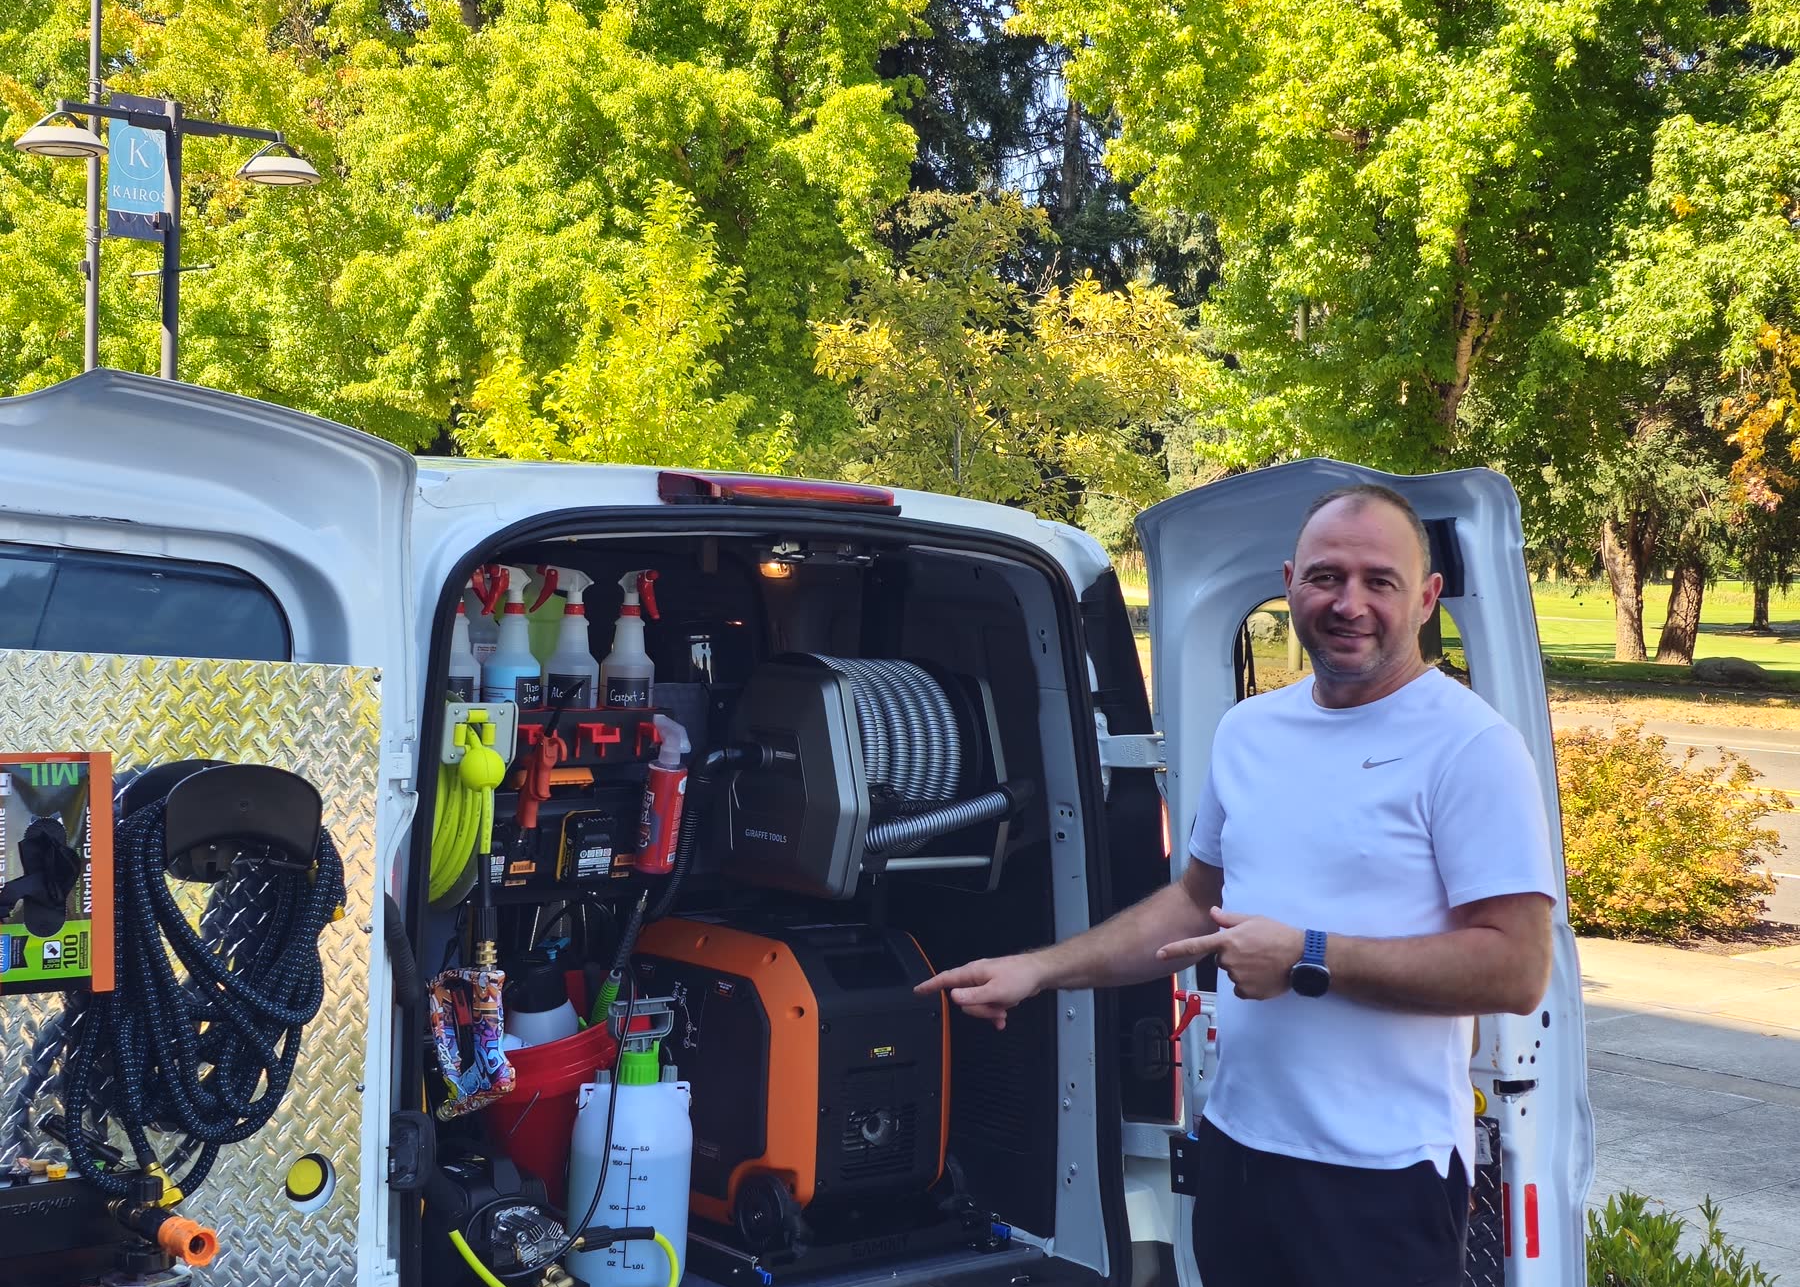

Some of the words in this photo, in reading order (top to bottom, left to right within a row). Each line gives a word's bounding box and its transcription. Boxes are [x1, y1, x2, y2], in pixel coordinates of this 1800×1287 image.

[128, 137, 150, 168] K
[745, 828, 768, 840] GIRAFFE
[769, 832, 787, 843] TOOLS
[83, 862, 92, 913] Nitrile
[63, 934, 78, 969] 100
[612, 1143, 627, 1152] Max.
